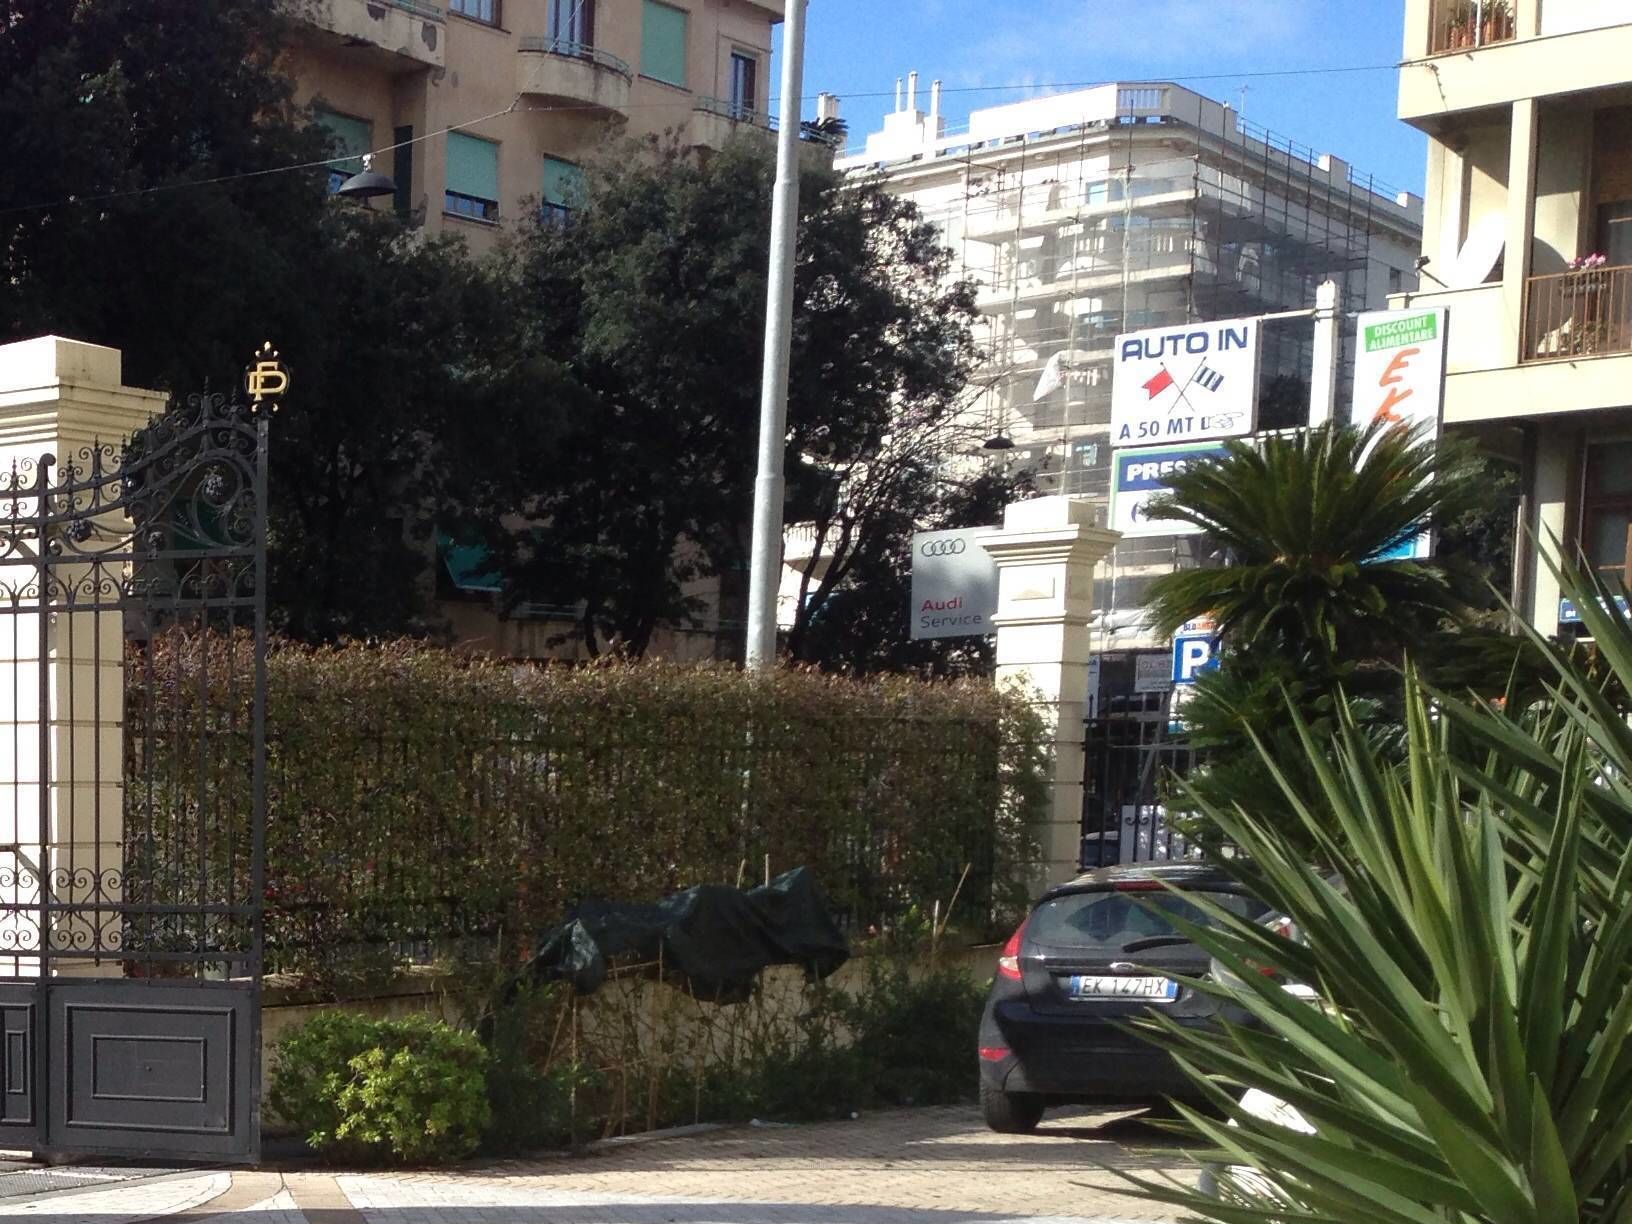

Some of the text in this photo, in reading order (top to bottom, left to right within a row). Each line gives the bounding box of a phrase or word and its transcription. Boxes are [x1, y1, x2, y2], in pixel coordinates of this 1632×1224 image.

[1374, 316, 1428, 337] DISCOUNT
[1122, 326, 1248, 362] AUTO IN
[1369, 327, 1434, 350] ALIMENTARE
[1119, 423, 1131, 440] A
[1138, 420, 1160, 438] 50
[1167, 416, 1194, 435] MT
[921, 596, 962, 612] Audi
[920, 614, 982, 629] Service
[1181, 640, 1210, 680] P
[1082, 977, 1166, 996] EK 147HX
